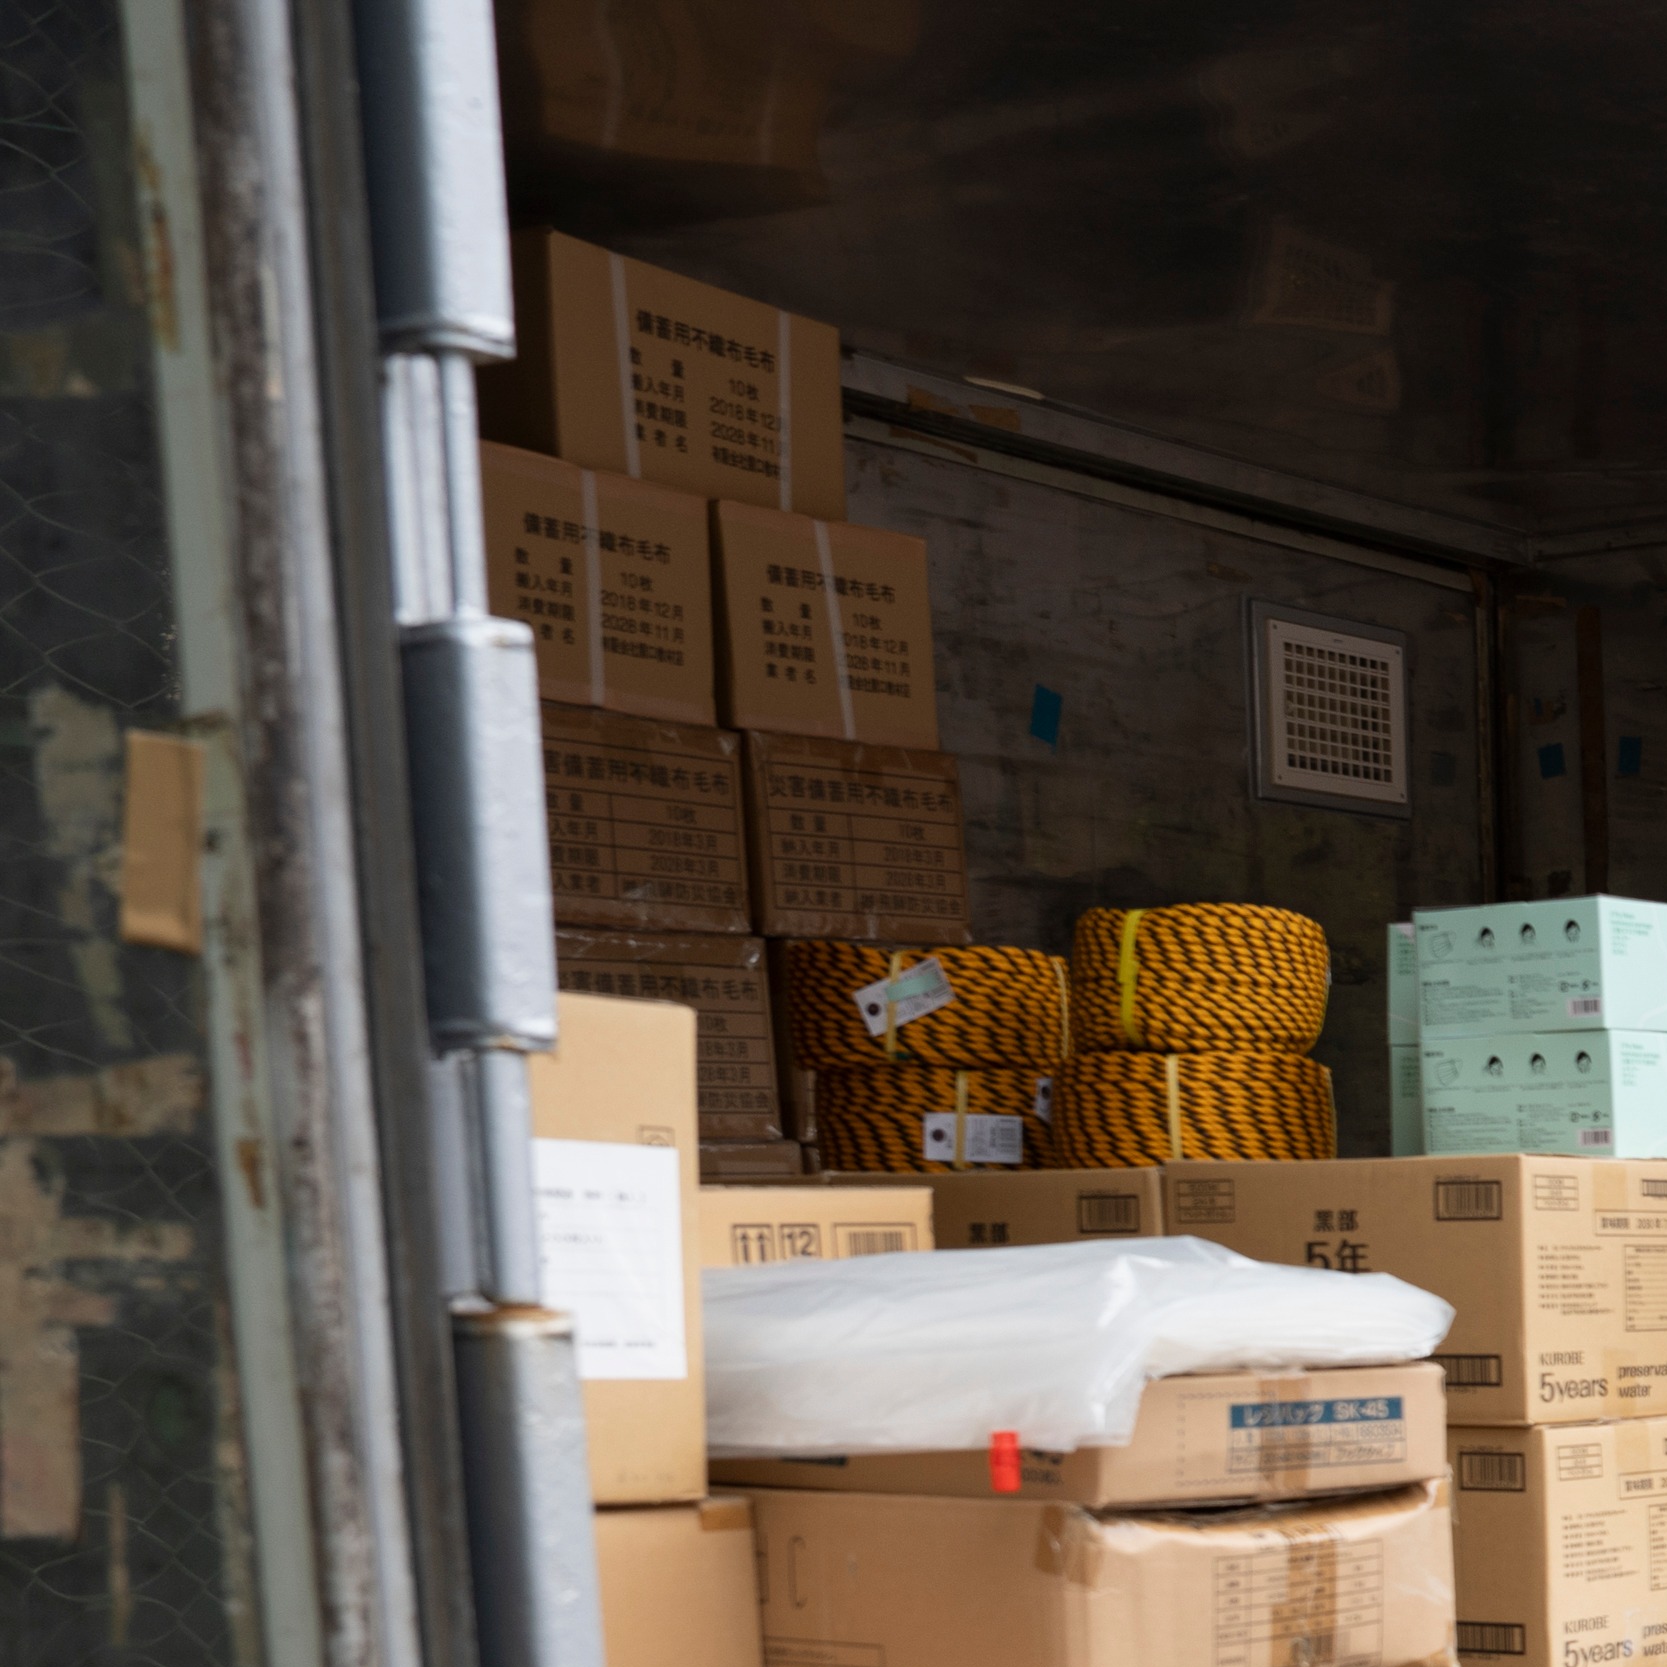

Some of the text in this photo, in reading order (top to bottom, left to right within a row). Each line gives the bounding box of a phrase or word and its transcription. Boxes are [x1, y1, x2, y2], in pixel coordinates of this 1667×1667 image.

[709, 396, 786, 433] 2018年12
[710, 420, 787, 455] 2028年11
[837, 632, 909, 657] 018年12月
[839, 652, 911, 678] 028年11月
[1314, 1208, 1359, 1233] 黒部
[1539, 1351, 1585, 1366] KUROBE
[1539, 1372, 1609, 1404] 5years
[1619, 1385, 1651, 1399] water
[1332, 1399, 1390, 1421] SK-45
[1563, 1614, 1610, 1635] KUROBE
